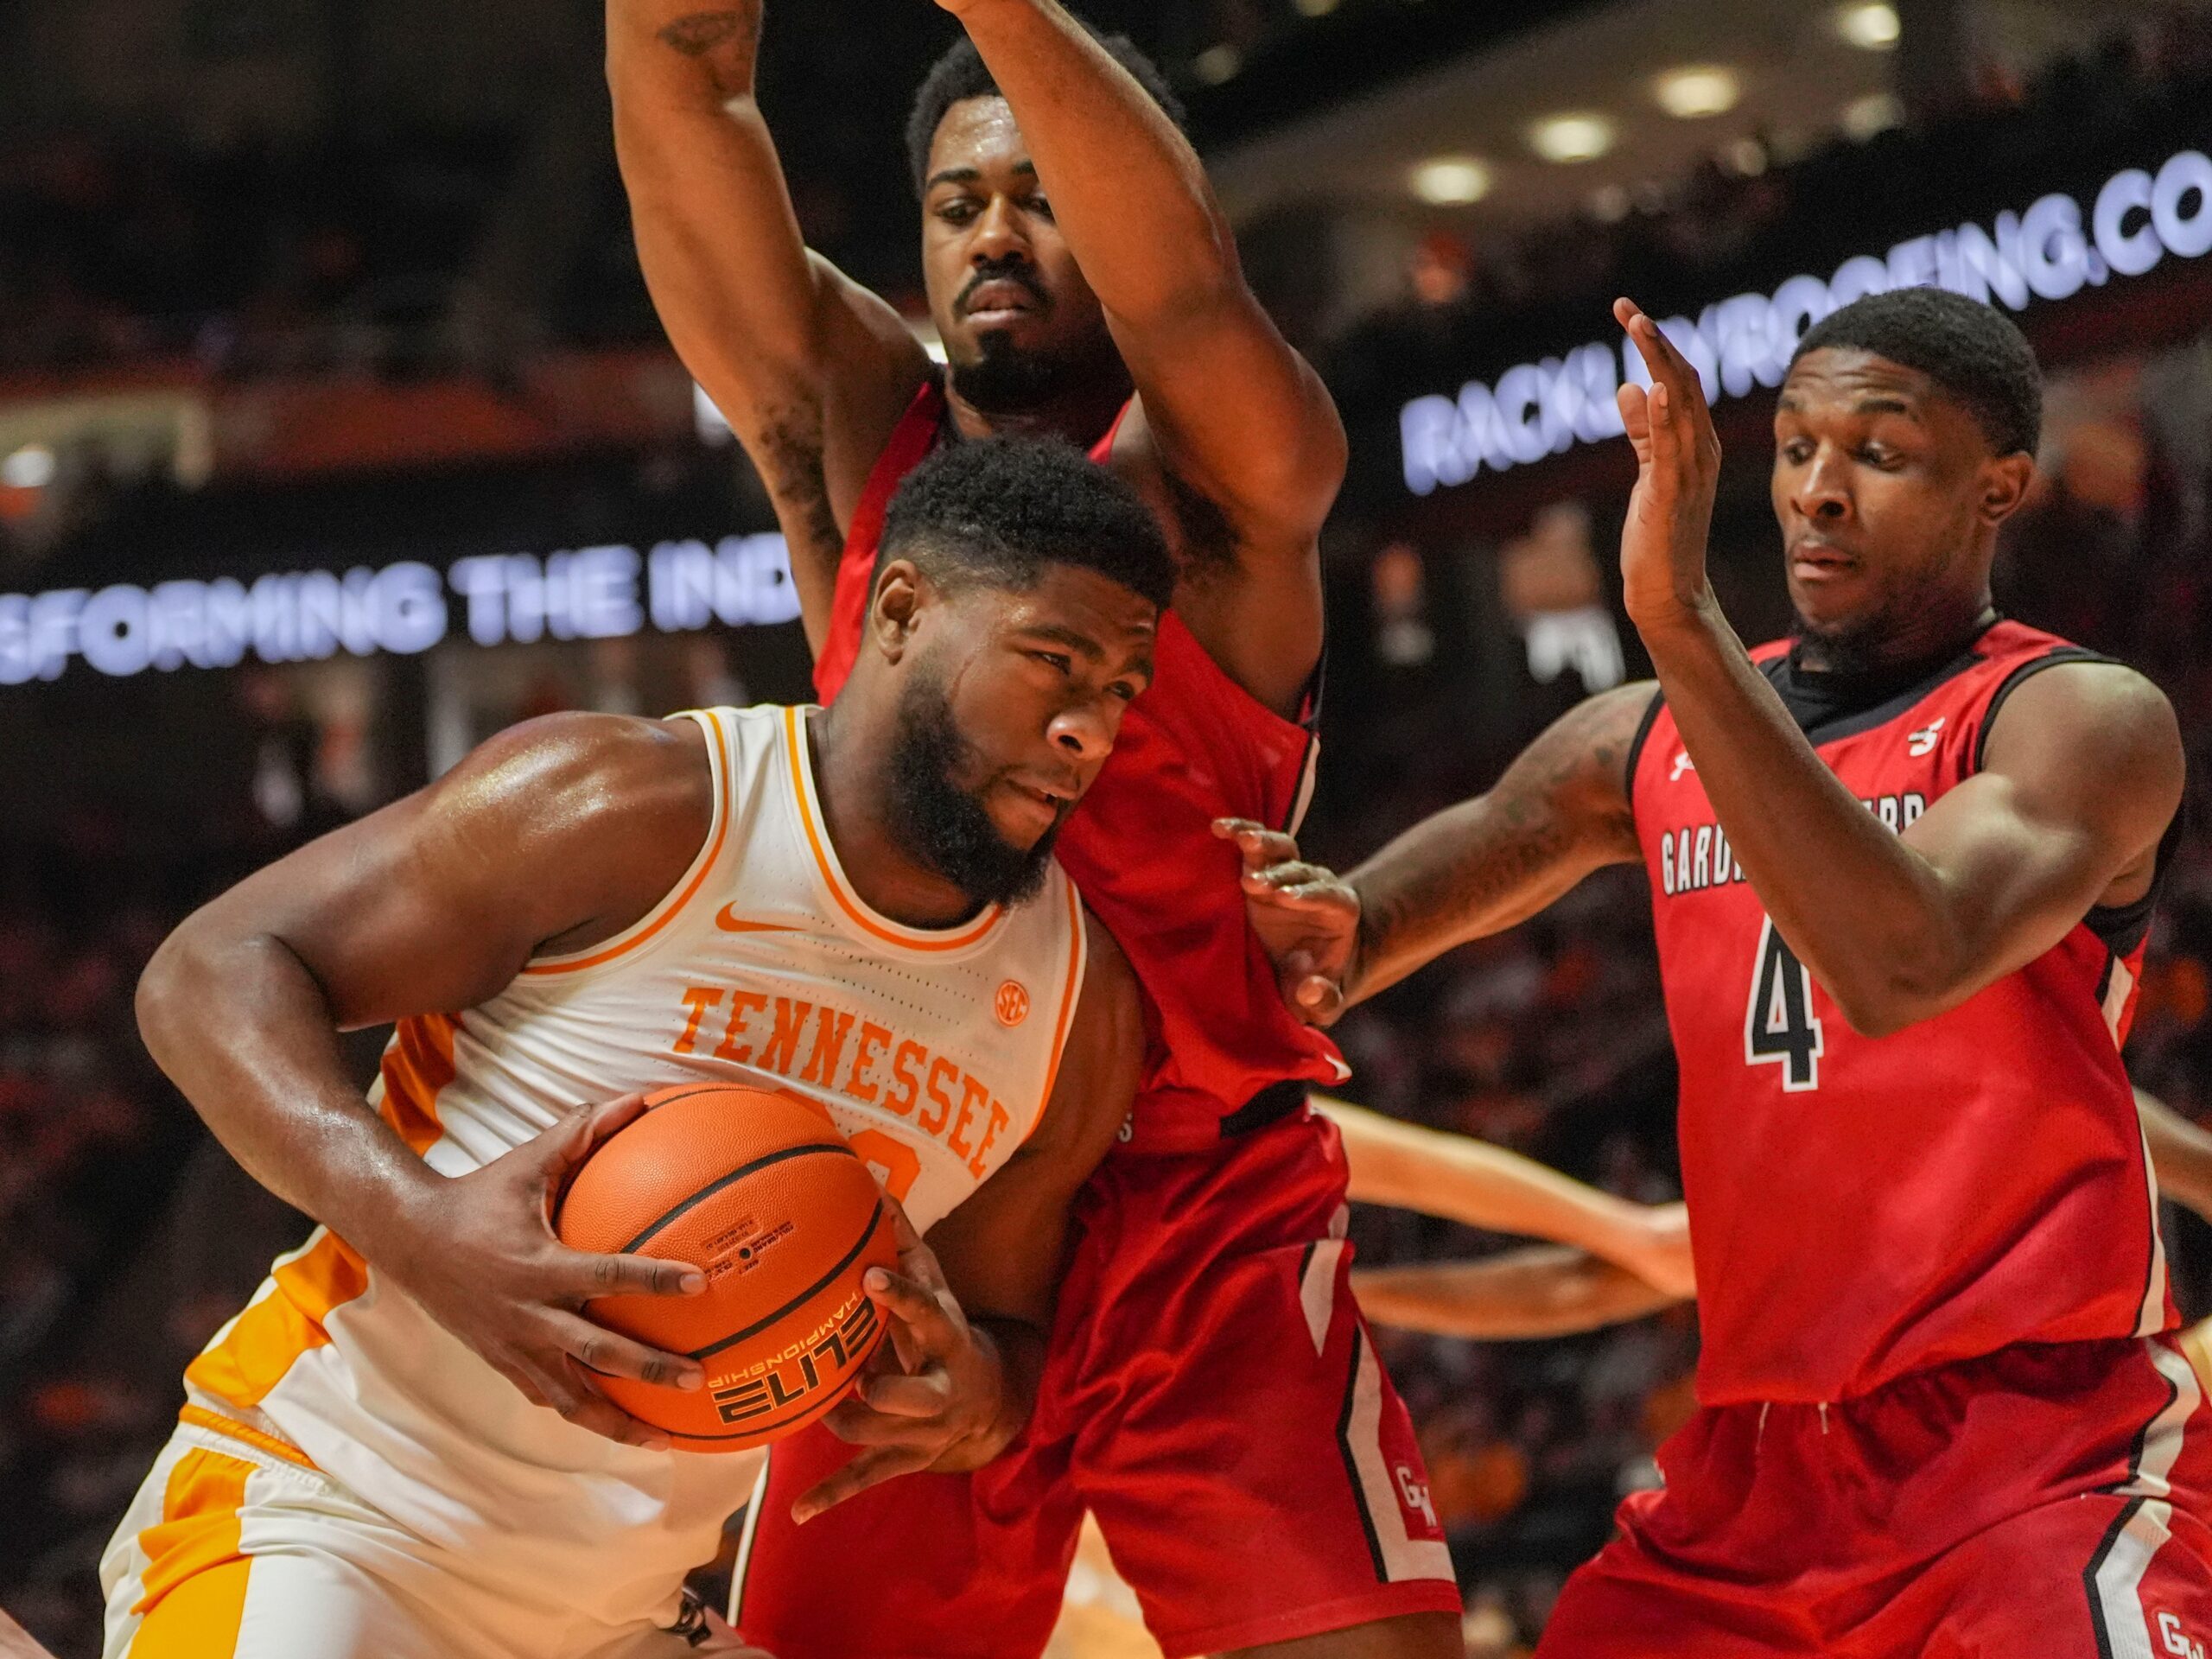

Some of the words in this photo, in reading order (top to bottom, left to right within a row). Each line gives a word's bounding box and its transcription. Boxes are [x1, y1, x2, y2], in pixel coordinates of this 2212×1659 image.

[448, 544, 645, 646] THE
[1743, 912, 1824, 1093] 4
[671, 987, 1010, 1180] TENNESSEE
[708, 1292, 858, 1389] HAMPIONSHIP
[711, 1295, 880, 1426] ELITE
